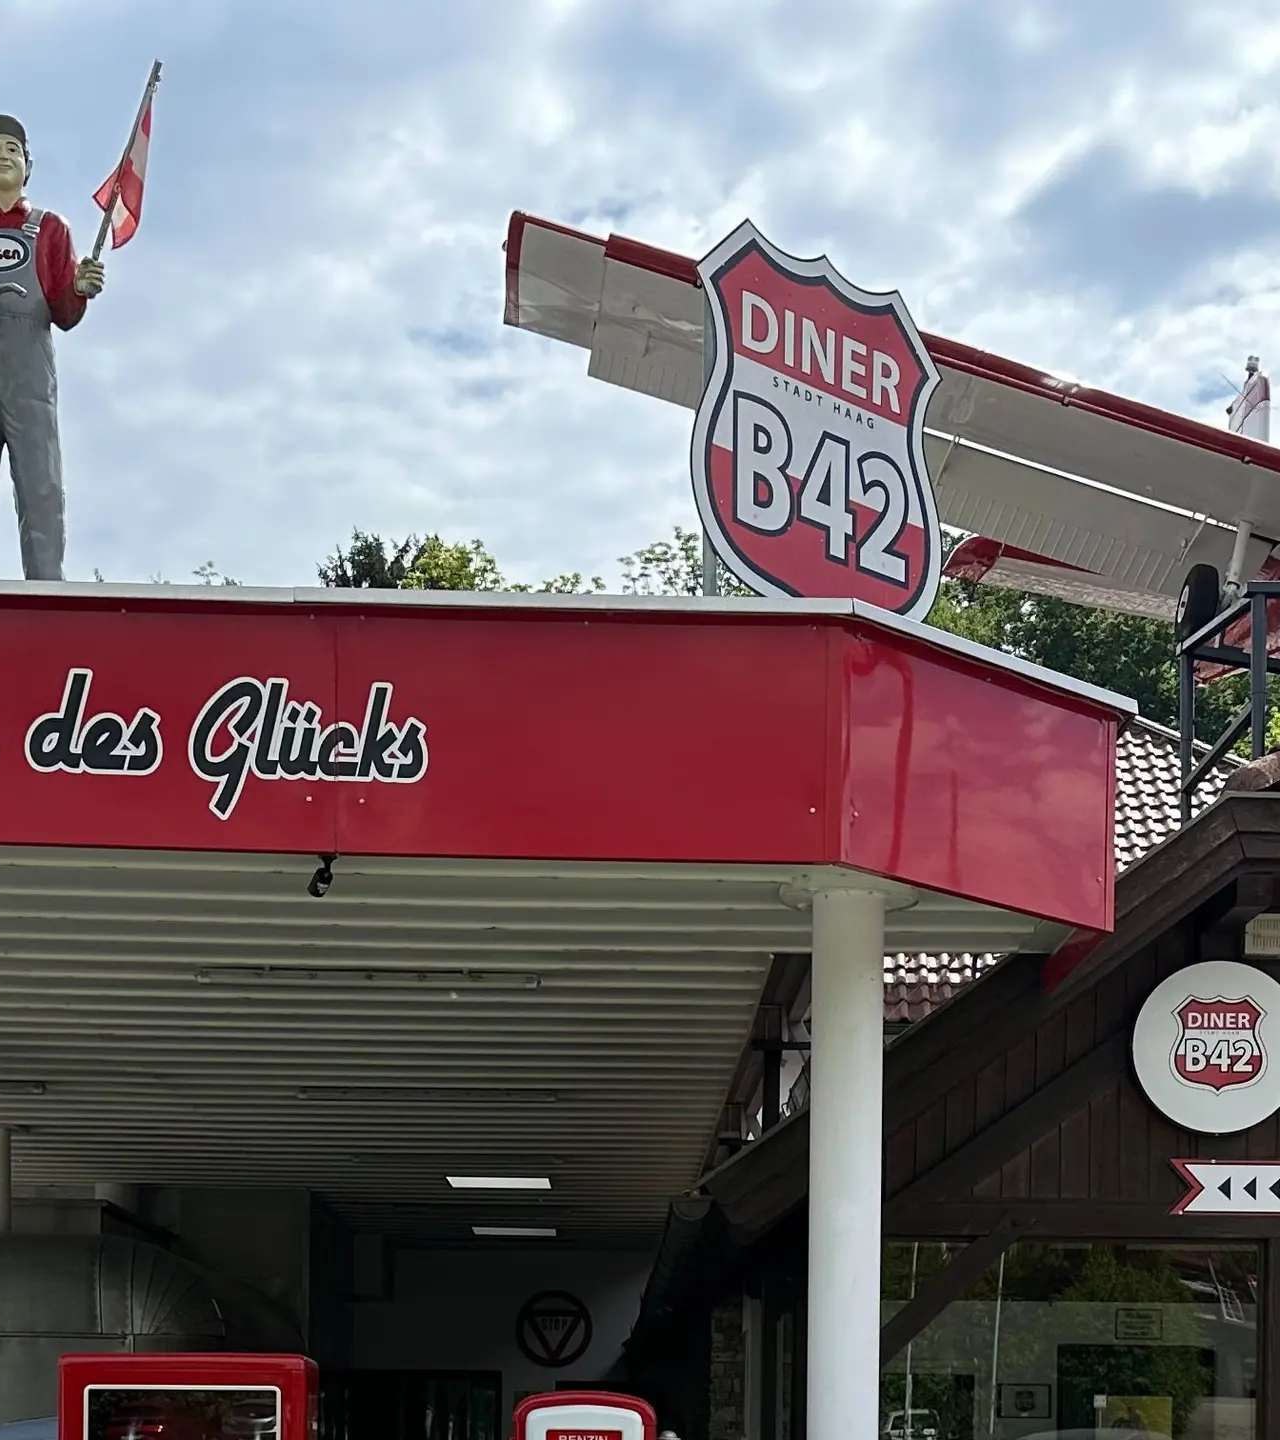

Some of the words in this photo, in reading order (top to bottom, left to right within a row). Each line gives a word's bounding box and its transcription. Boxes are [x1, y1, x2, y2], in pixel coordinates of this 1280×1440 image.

[740, 289, 901, 416] DINER
[772, 376, 823, 407] STADT
[833, 402, 875, 430] HAAG
[732, 389, 910, 590] B42
[25, 668, 163, 776] des
[187, 677, 428, 821] Glücks
[1187, 1012, 1251, 1028] DINER
[1184, 1038, 1254, 1074] B42
[541, 1318, 568, 1331] STOP
